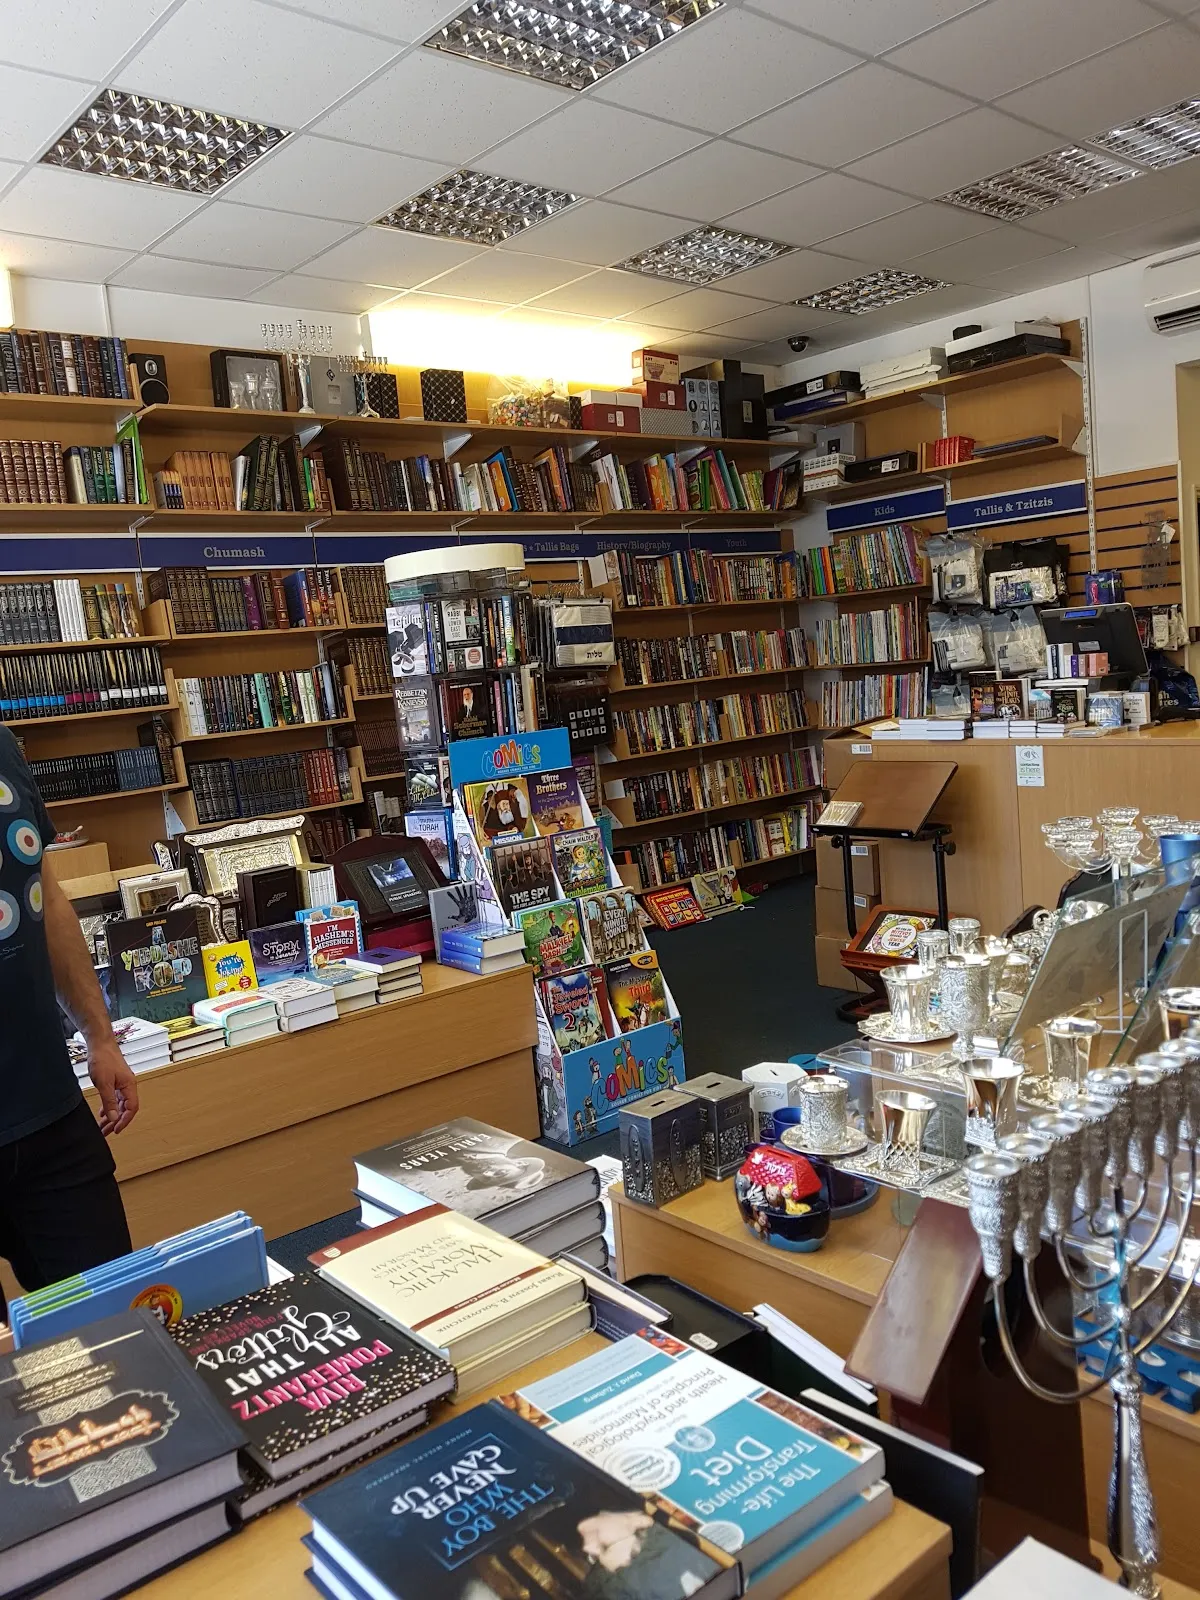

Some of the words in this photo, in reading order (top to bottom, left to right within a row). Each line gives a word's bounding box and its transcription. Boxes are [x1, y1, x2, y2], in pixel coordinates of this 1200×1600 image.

[874, 505, 895, 517] Kids
[974, 504, 1003, 517] Tallis
[1005, 503, 1014, 512] &
[1016, 497, 1054, 511] Tzitzis
[203, 546, 266, 558] Chumash
[535, 543, 559, 552] Tallis
[560, 543, 580, 553] Bags
[597, 540, 672, 551] History/Biography
[726, 539, 747, 548] Youth
[392, 614, 422, 629] Tefillin
[447, 610, 461, 618] RABBI
[587, 651, 603, 660] טלית
[395, 688, 428, 699] REBBETZIN
[1002, 696, 1020, 704] HEARTS
[1004, 690, 1019, 698] UNITE
[536, 781, 567, 795] Brothers
[541, 773, 560, 784] Three
[419, 823, 439, 831] TORAH
[494, 834, 523, 846] MISSION
[562, 837, 576, 846] CHAIM
[577, 834, 595, 843] WALDER
[510, 891, 530, 905] THE
[530, 885, 550, 899] SPY
[604, 907, 626, 920] EVERY
[327, 923, 339, 932] I'M
[603, 916, 628, 932] MINUTE
[152, 925, 166, 945] A
[313, 931, 354, 944] HASHEM'S
[316, 938, 354, 950] MESSENGER
[540, 933, 573, 954] MALKIEL
[120, 936, 199, 972] YIDDISHE
[263, 939, 301, 956] STORM
[542, 949, 560, 961] DASH
[133, 957, 193, 992] KOP
[628, 981, 651, 998] Third
[554, 995, 589, 1015] Sword
[563, 1012, 576, 1031] 2
[448, 1133, 492, 1152] EARLY
[400, 1150, 448, 1170] YEARS
[371, 1243, 432, 1272] MASORAH
[419, 1249, 437, 1260] ON
[374, 1259, 419, 1279] ETHICS
[389, 1242, 488, 1288] MORALITY
[395, 1249, 503, 1298] HALAKHIC
[195, 1305, 351, 1371] Glitters
[308, 1324, 362, 1356] ALL
[224, 1352, 305, 1397] THAT
[231, 1338, 394, 1421] POMERANTZ
[621, 1371, 643, 1385] David
[661, 1367, 716, 1399] Principles
[295, 1372, 367, 1412] RIVA
[583, 1387, 614, 1404] Zulberg
[688, 1374, 728, 1400] Health
[648, 1398, 661, 1410] of
[668, 1397, 689, 1414] and
[572, 1406, 649, 1449] Maimonides
[585, 1412, 667, 1459] Psychological
[429, 1444, 502, 1490] GAVE
[689, 1435, 773, 1487] Diet
[695, 1439, 817, 1516] Transforming
[779, 1463, 821, 1488] The
[390, 1485, 431, 1516] UP
[412, 1462, 518, 1520] NEVER
[740, 1485, 786, 1516] Life-
[445, 1479, 515, 1526] WHO
[496, 1482, 554, 1520] THE
[441, 1514, 497, 1558] BOY
